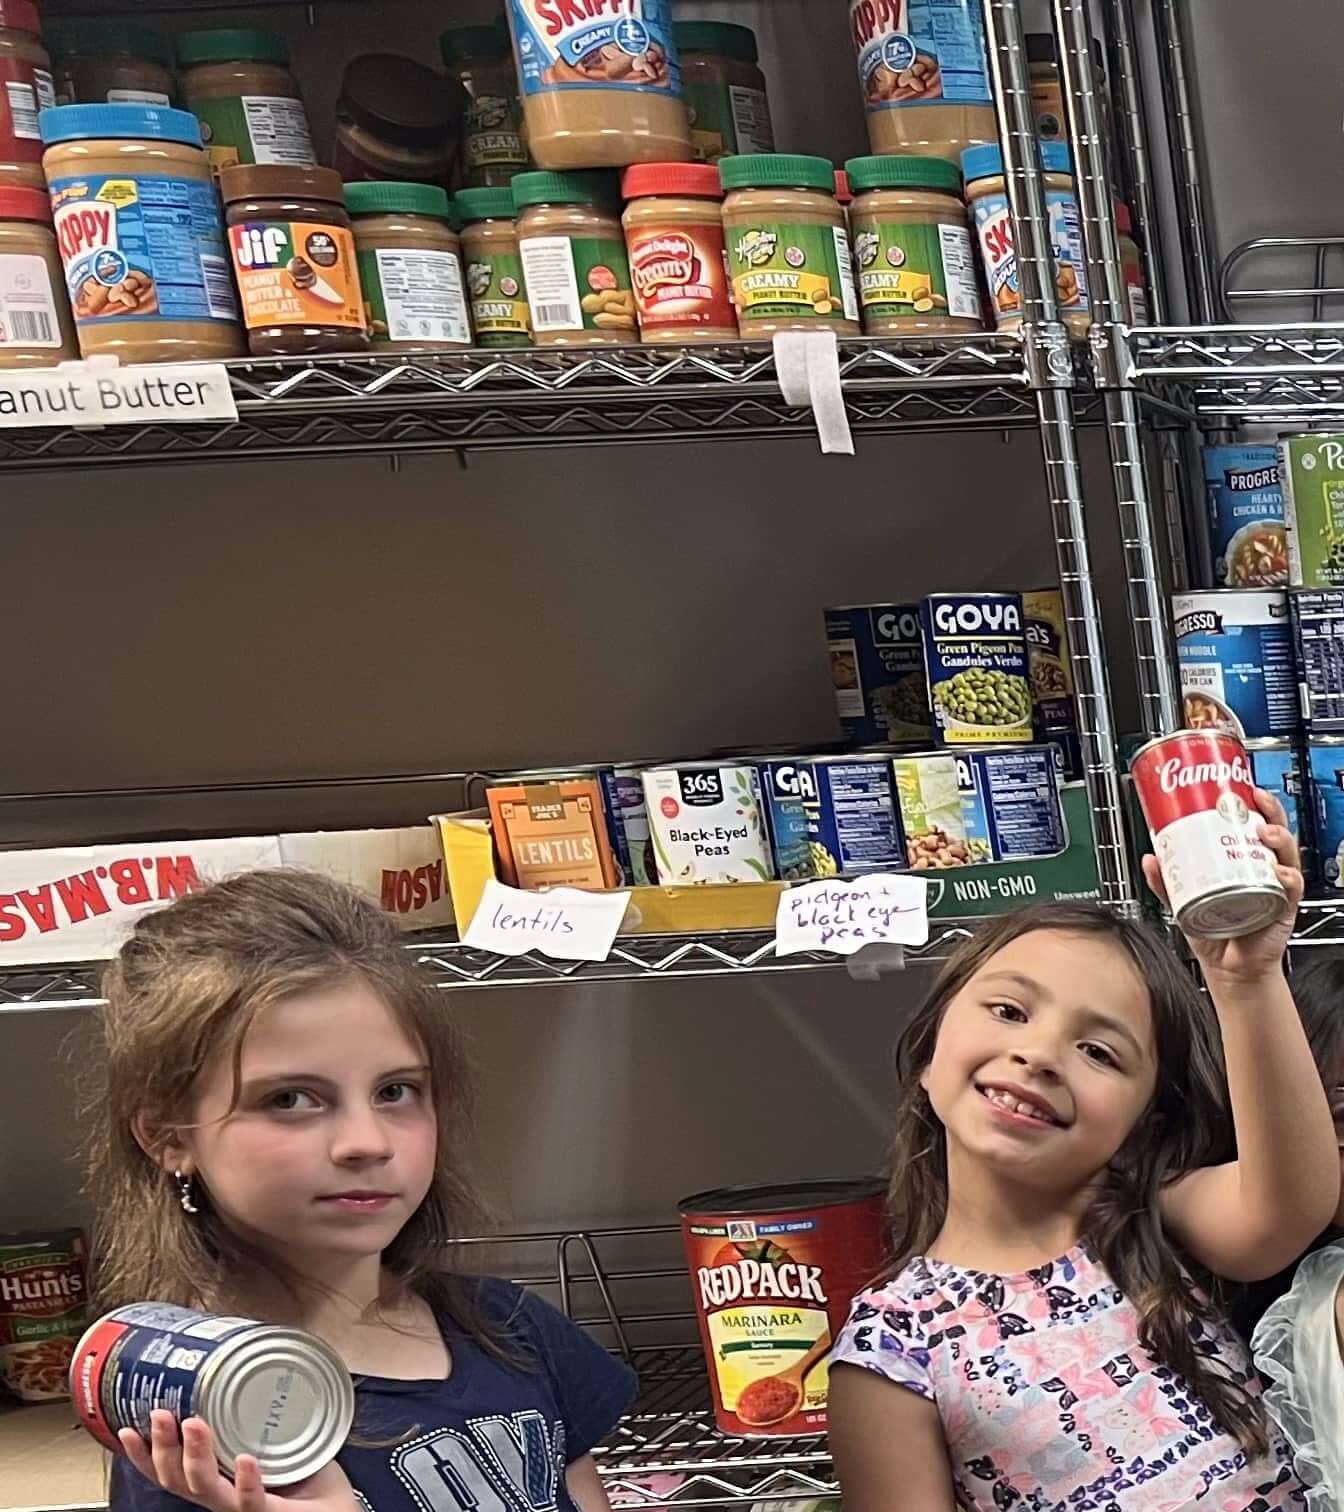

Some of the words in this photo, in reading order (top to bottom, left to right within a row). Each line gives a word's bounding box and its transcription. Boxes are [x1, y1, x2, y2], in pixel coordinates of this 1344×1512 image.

[237, 227, 289, 266] Jif
[741, 275, 800, 290] CREAMY
[0, 381, 85, 414] anut
[97, 377, 211, 411] Butter
[935, 602, 1021, 633] GOYA
[941, 655, 991, 668] Gandules
[683, 774, 718, 795] 365
[669, 825, 748, 842] Black-Eyed
[518, 839, 593, 866] LENTILS
[694, 843, 730, 857] Peas
[953, 875, 1036, 901] NON-GMO
[492, 904, 573, 935] lentils
[0, 1271, 83, 1303] Hunt's
[697, 1260, 828, 1309] REDPACK
[721, 1312, 803, 1329] MARINARA
[744, 1328, 774, 1338] SAUCE
